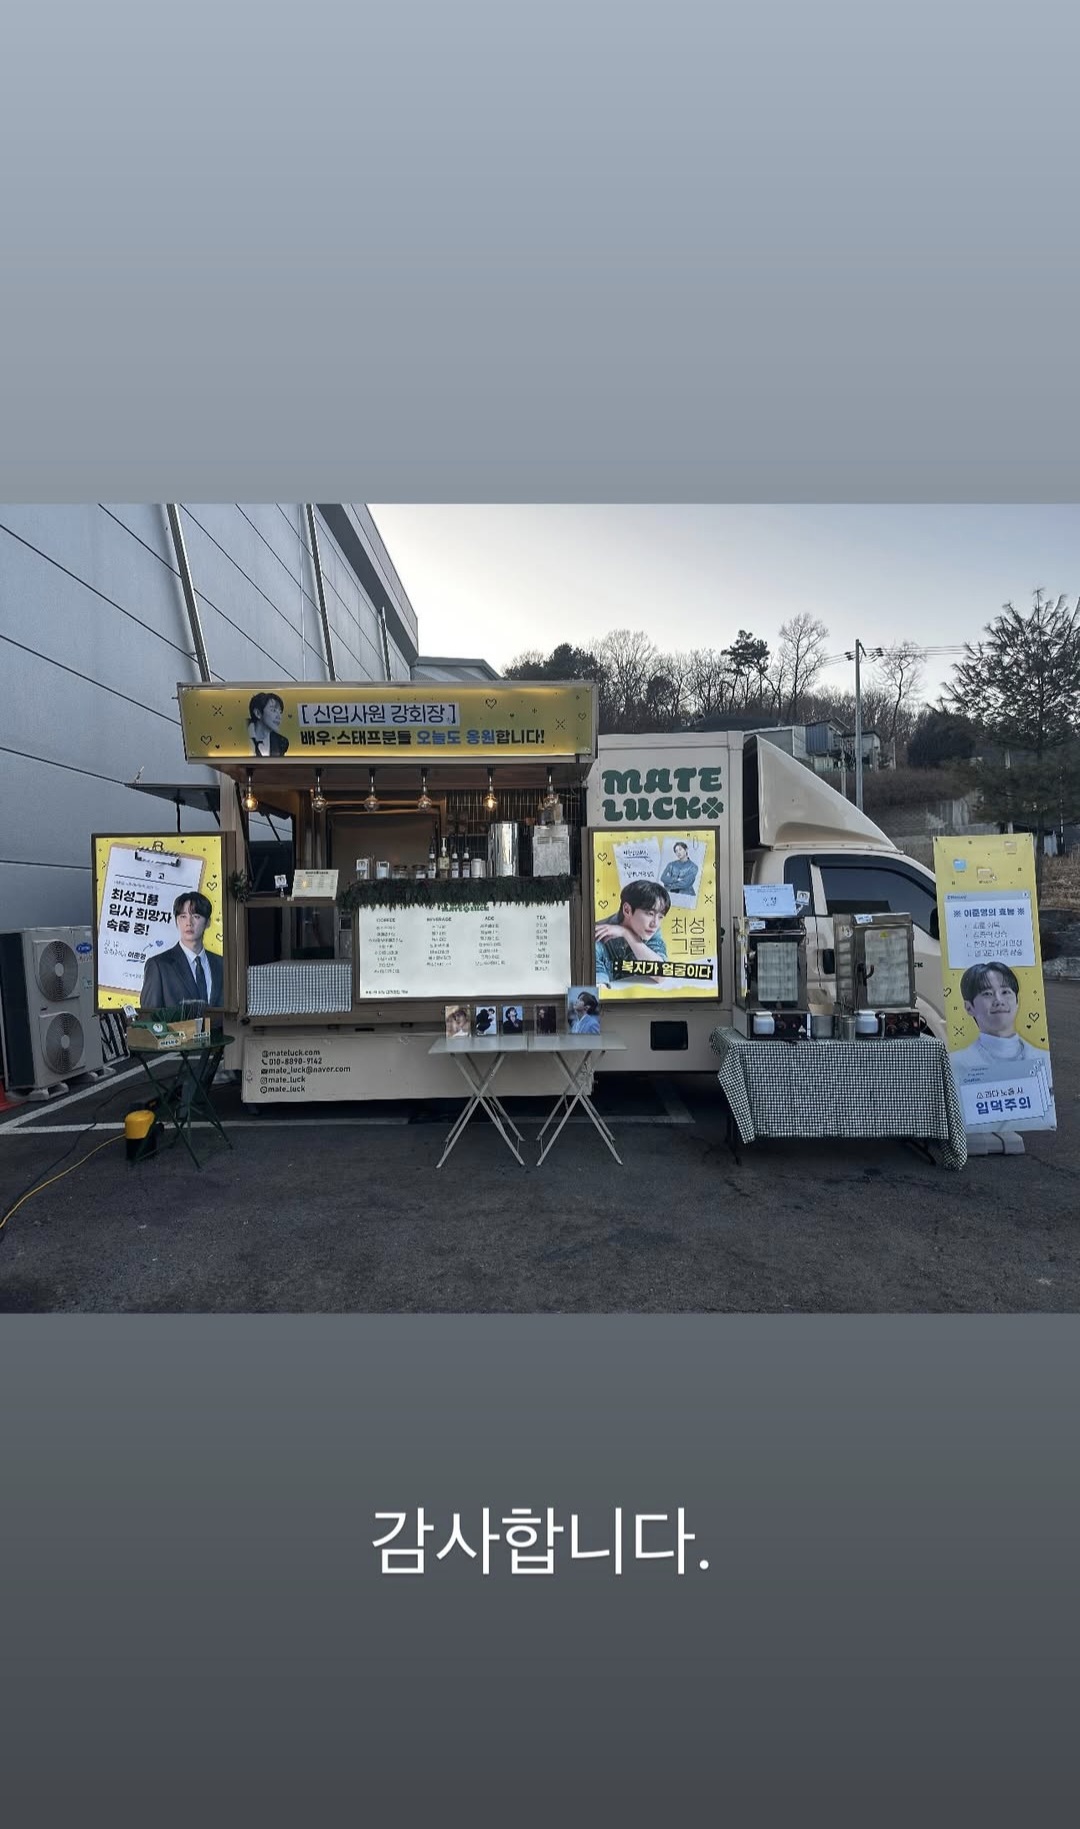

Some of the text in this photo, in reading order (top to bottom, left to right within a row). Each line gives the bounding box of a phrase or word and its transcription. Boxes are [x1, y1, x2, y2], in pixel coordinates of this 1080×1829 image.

[417, 729, 461, 745] 오늘도
[466, 729, 545, 745] 응원합니다!
[602, 766, 722, 795] MATE
[602, 796, 701, 822] LUCK
[111, 888, 159, 906] 최성그룹
[109, 903, 172, 924] 입사 희망자
[107, 919, 150, 936] 속출 중!
[671, 916, 705, 935] 최성
[671, 938, 706, 956] 그룹
[621, 960, 659, 975] 복지가
[661, 963, 712, 978] 얼굴이다
[269, 1058, 322, 1066] 010-8890-9142
